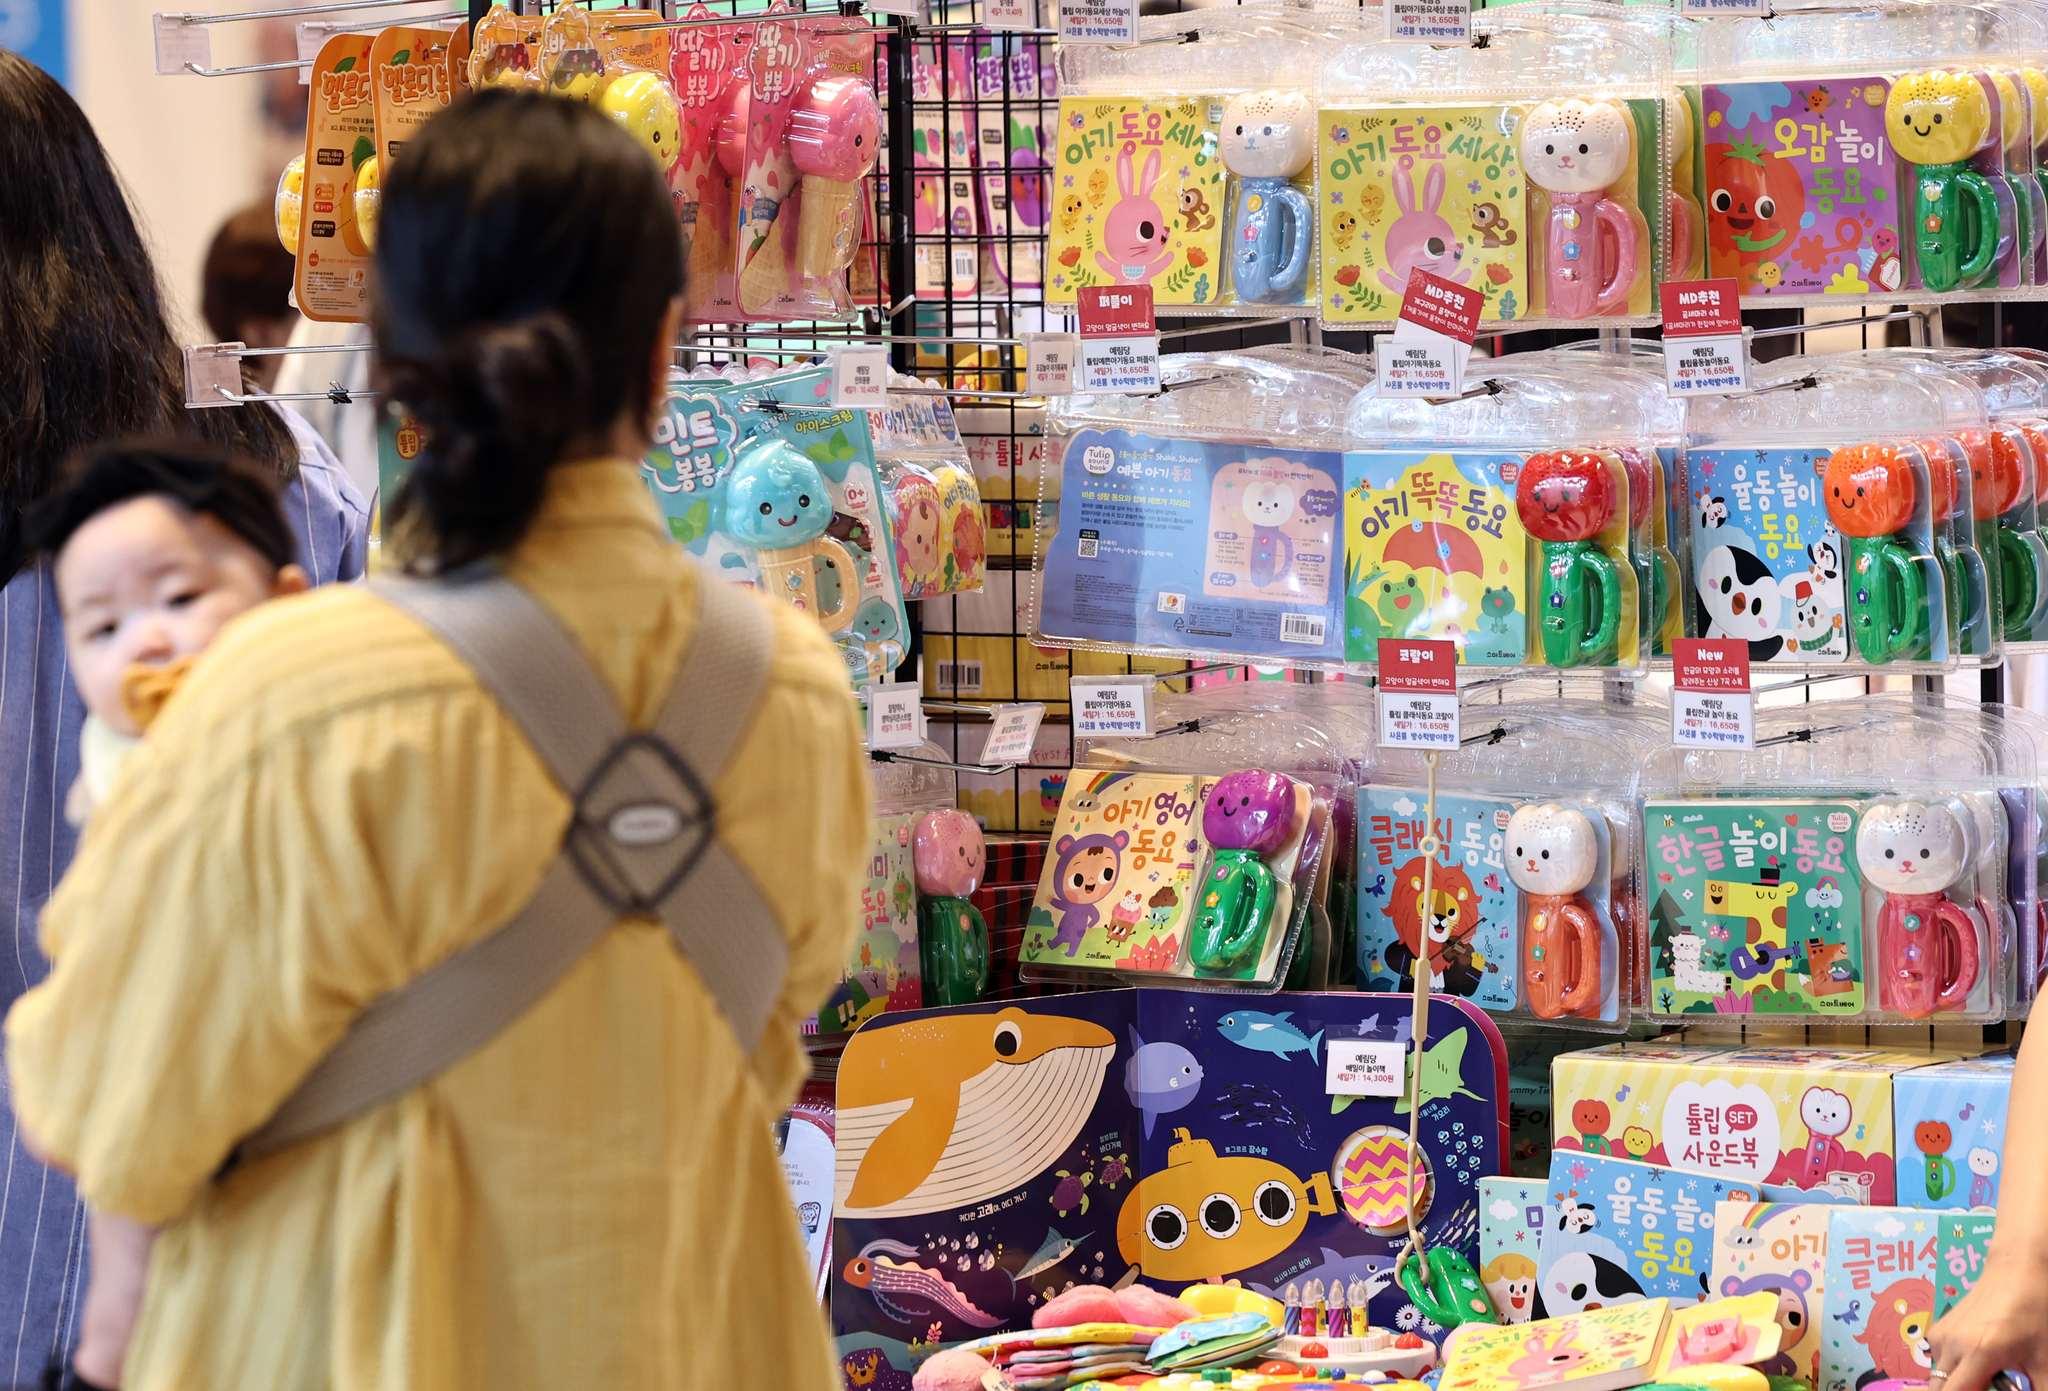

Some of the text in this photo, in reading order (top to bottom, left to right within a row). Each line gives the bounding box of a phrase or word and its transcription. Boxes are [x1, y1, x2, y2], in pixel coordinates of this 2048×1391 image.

[1075, 7, 1111, 16] 아기동요세상
[1112, 8, 1130, 17] 하늘이
[1447, 6, 1467, 14] 분홍이
[1069, 17, 1123, 26] 세일가 16,650원
[1401, 15, 1460, 25] 세일가 16,650원
[680, 26, 718, 72] 딸기
[760, 24, 793, 68] 딸기
[381, 65, 434, 103] 멜로디
[763, 70, 784, 105] 봉봉
[687, 74, 710, 108] 봉봉
[1065, 113, 1211, 167] 아기 동요 세상
[1774, 117, 1884, 166] 오감 놀이
[1330, 125, 1514, 181] 아기 동요 세상
[1809, 167, 1867, 215] 동요
[1098, 294, 1133, 309] 퍼플이
[1424, 283, 1466, 311] MD추천
[1678, 289, 1721, 306] MD추천
[1413, 296, 1470, 325] 개구리와 올챙이 수록
[1682, 308, 1720, 319] 곰세마리 수록
[1085, 321, 1150, 333] 고양이 얼굴색이 변해요
[1109, 345, 1131, 356] 예림당
[1405, 349, 1427, 359] 예림당
[1692, 347, 1715, 357] 예림당
[1136, 355, 1155, 364] 퍼플이
[1679, 358, 1730, 368] 튤립율동놀이동요
[1094, 366, 1150, 375] 세일가 16,650원
[1389, 370, 1445, 379] 세일가 16,650원
[1677, 366, 1735, 378] 세일가 16,650원
[794, 409, 855, 435] 아이스크림
[655, 409, 720, 457] 민트
[1088, 449, 1111, 459] Tulip
[1155, 453, 1202, 464] Shake, Shake!
[675, 452, 717, 493] 봉봉
[1116, 462, 1193, 483] 예쁜 아기 동요
[1502, 464, 1517, 472] Tulip
[1731, 464, 1816, 512] 율동 놀이
[1081, 491, 1095, 500] 바른
[1097, 493, 1111, 501] 생활
[1111, 493, 1131, 503] 동요와
[1132, 495, 1146, 504] 함께
[1168, 498, 1191, 508] 자라요!
[1361, 472, 1506, 540] 아기 똑똑 동요
[1759, 514, 1803, 559] 동요
[1399, 648, 1434, 664] 코랄이
[1697, 648, 1724, 661] New
[1683, 666, 1740, 675] 한글의 모양과 소리를
[1385, 677, 1450, 687] 고양이 얼굴색이 변해요
[1681, 677, 1743, 686] 알려주는 신상 7곡 수록
[1097, 690, 1118, 700] 예림당
[1409, 701, 1432, 711] 예림당
[1701, 699, 1723, 710] 예림당
[1082, 711, 1136, 719] 세일가 16,650원
[1389, 711, 1454, 721] 튤립 클래식동요 코랄이
[1685, 708, 1739, 720] 튤립한글 놀이 동요
[1393, 721, 1449, 731] 세일가 16,650원
[1683, 718, 1740, 731] 세일가 16,650원
[1103, 791, 1197, 826] 아기 영어
[1831, 814, 1848, 822] Tulip
[1369, 815, 1506, 870] 클래식 동요
[1656, 821, 1845, 877] 한글 놀이 동요
[1130, 829, 1177, 870] 동요
[1819, 999, 1855, 1008] 스마트베어
[1355, 1054, 1377, 1063] 예림당
[1345, 1064, 1386, 1073] 배밀이 놀이책
[1336, 1073, 1394, 1084] 세일가 14,300원
[1431, 1105, 1451, 1122] 가오리
[1685, 1103, 1754, 1136] 튤립 SET
[1099, 1141, 1122, 1153] 바다거북
[1248, 1144, 1269, 1156] 잠수함
[1682, 1136, 1760, 1169] 사운드북
[1730, 1190, 1748, 1201] Tulip
[958, 1191, 1028, 1223] 커다란 고래야, 어디 가니?
[1606, 1176, 1667, 1230] 율동
[1634, 1231, 1695, 1278] 동요
[1273, 1257, 1312, 1284] 무시무시한 상어
[1460, 1330, 1521, 1356] 아기
